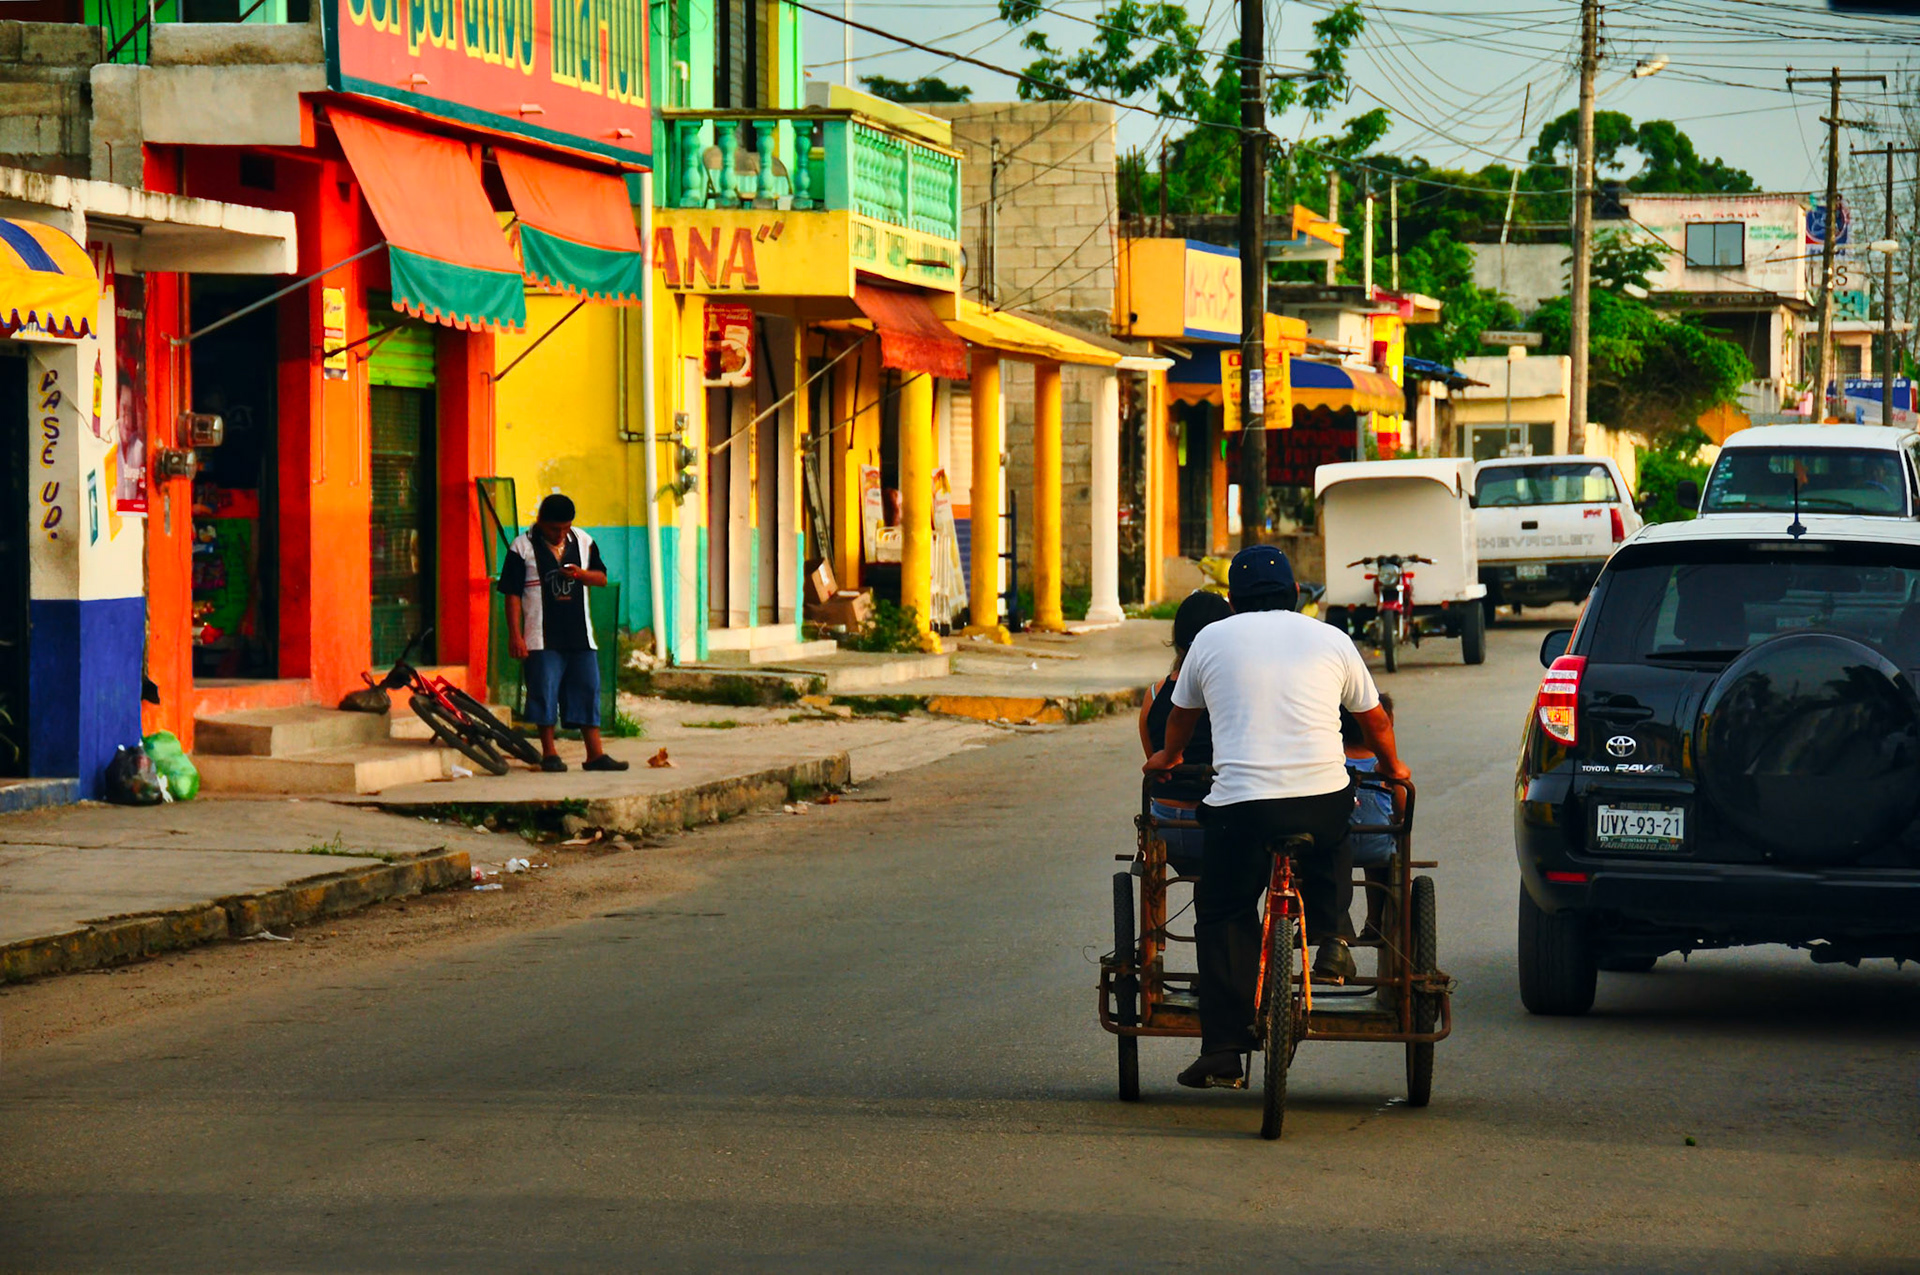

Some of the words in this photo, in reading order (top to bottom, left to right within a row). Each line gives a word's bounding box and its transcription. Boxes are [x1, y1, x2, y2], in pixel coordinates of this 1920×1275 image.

[39, 370, 62, 468] PASE
[1476, 533, 1596, 549] HEVROLET
[1615, 763, 1664, 773] RAV4
[1600, 814, 1680, 836] UVX-93-21
